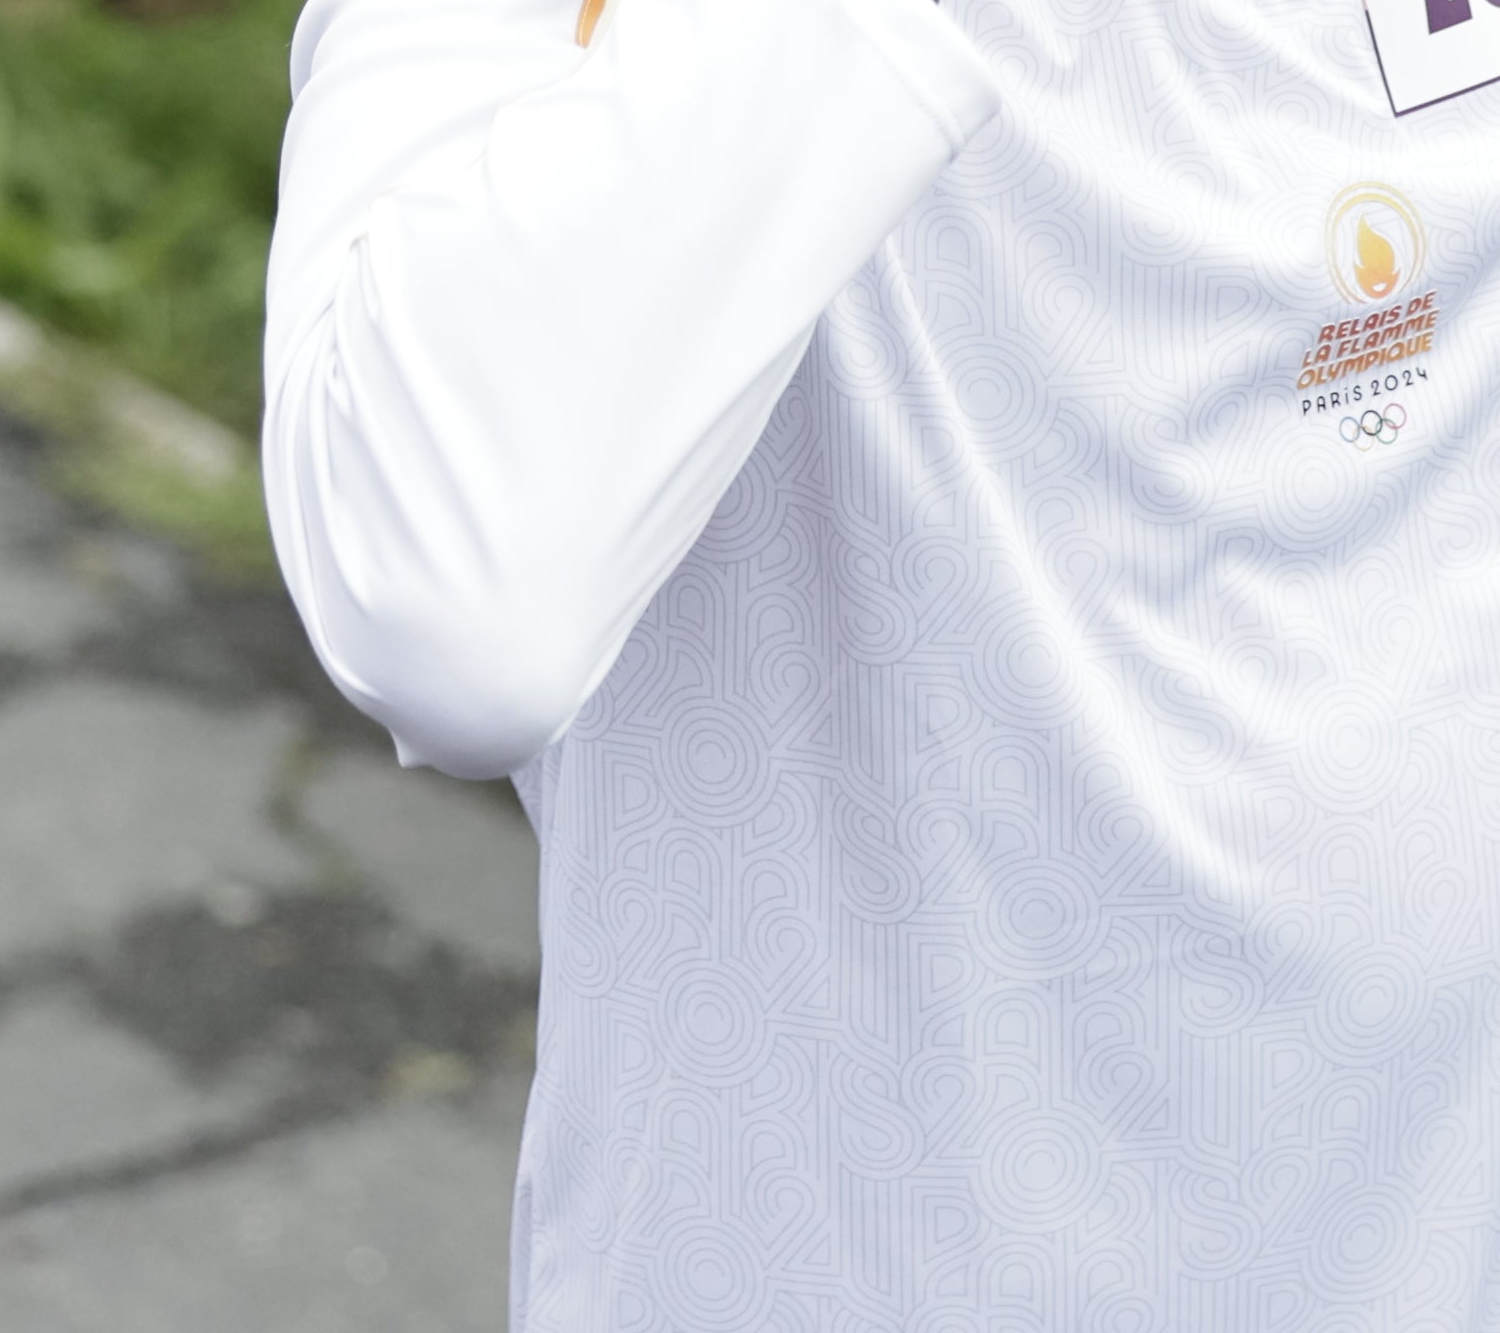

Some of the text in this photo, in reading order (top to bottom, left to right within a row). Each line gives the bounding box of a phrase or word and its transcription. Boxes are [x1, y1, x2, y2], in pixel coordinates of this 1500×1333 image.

[1301, 310, 1440, 368] LA FLAMME
[1317, 290, 1437, 344] RELAIS DE
[1296, 333, 1434, 390] OLYMPIQUE
[1370, 367, 1428, 396] 2024
